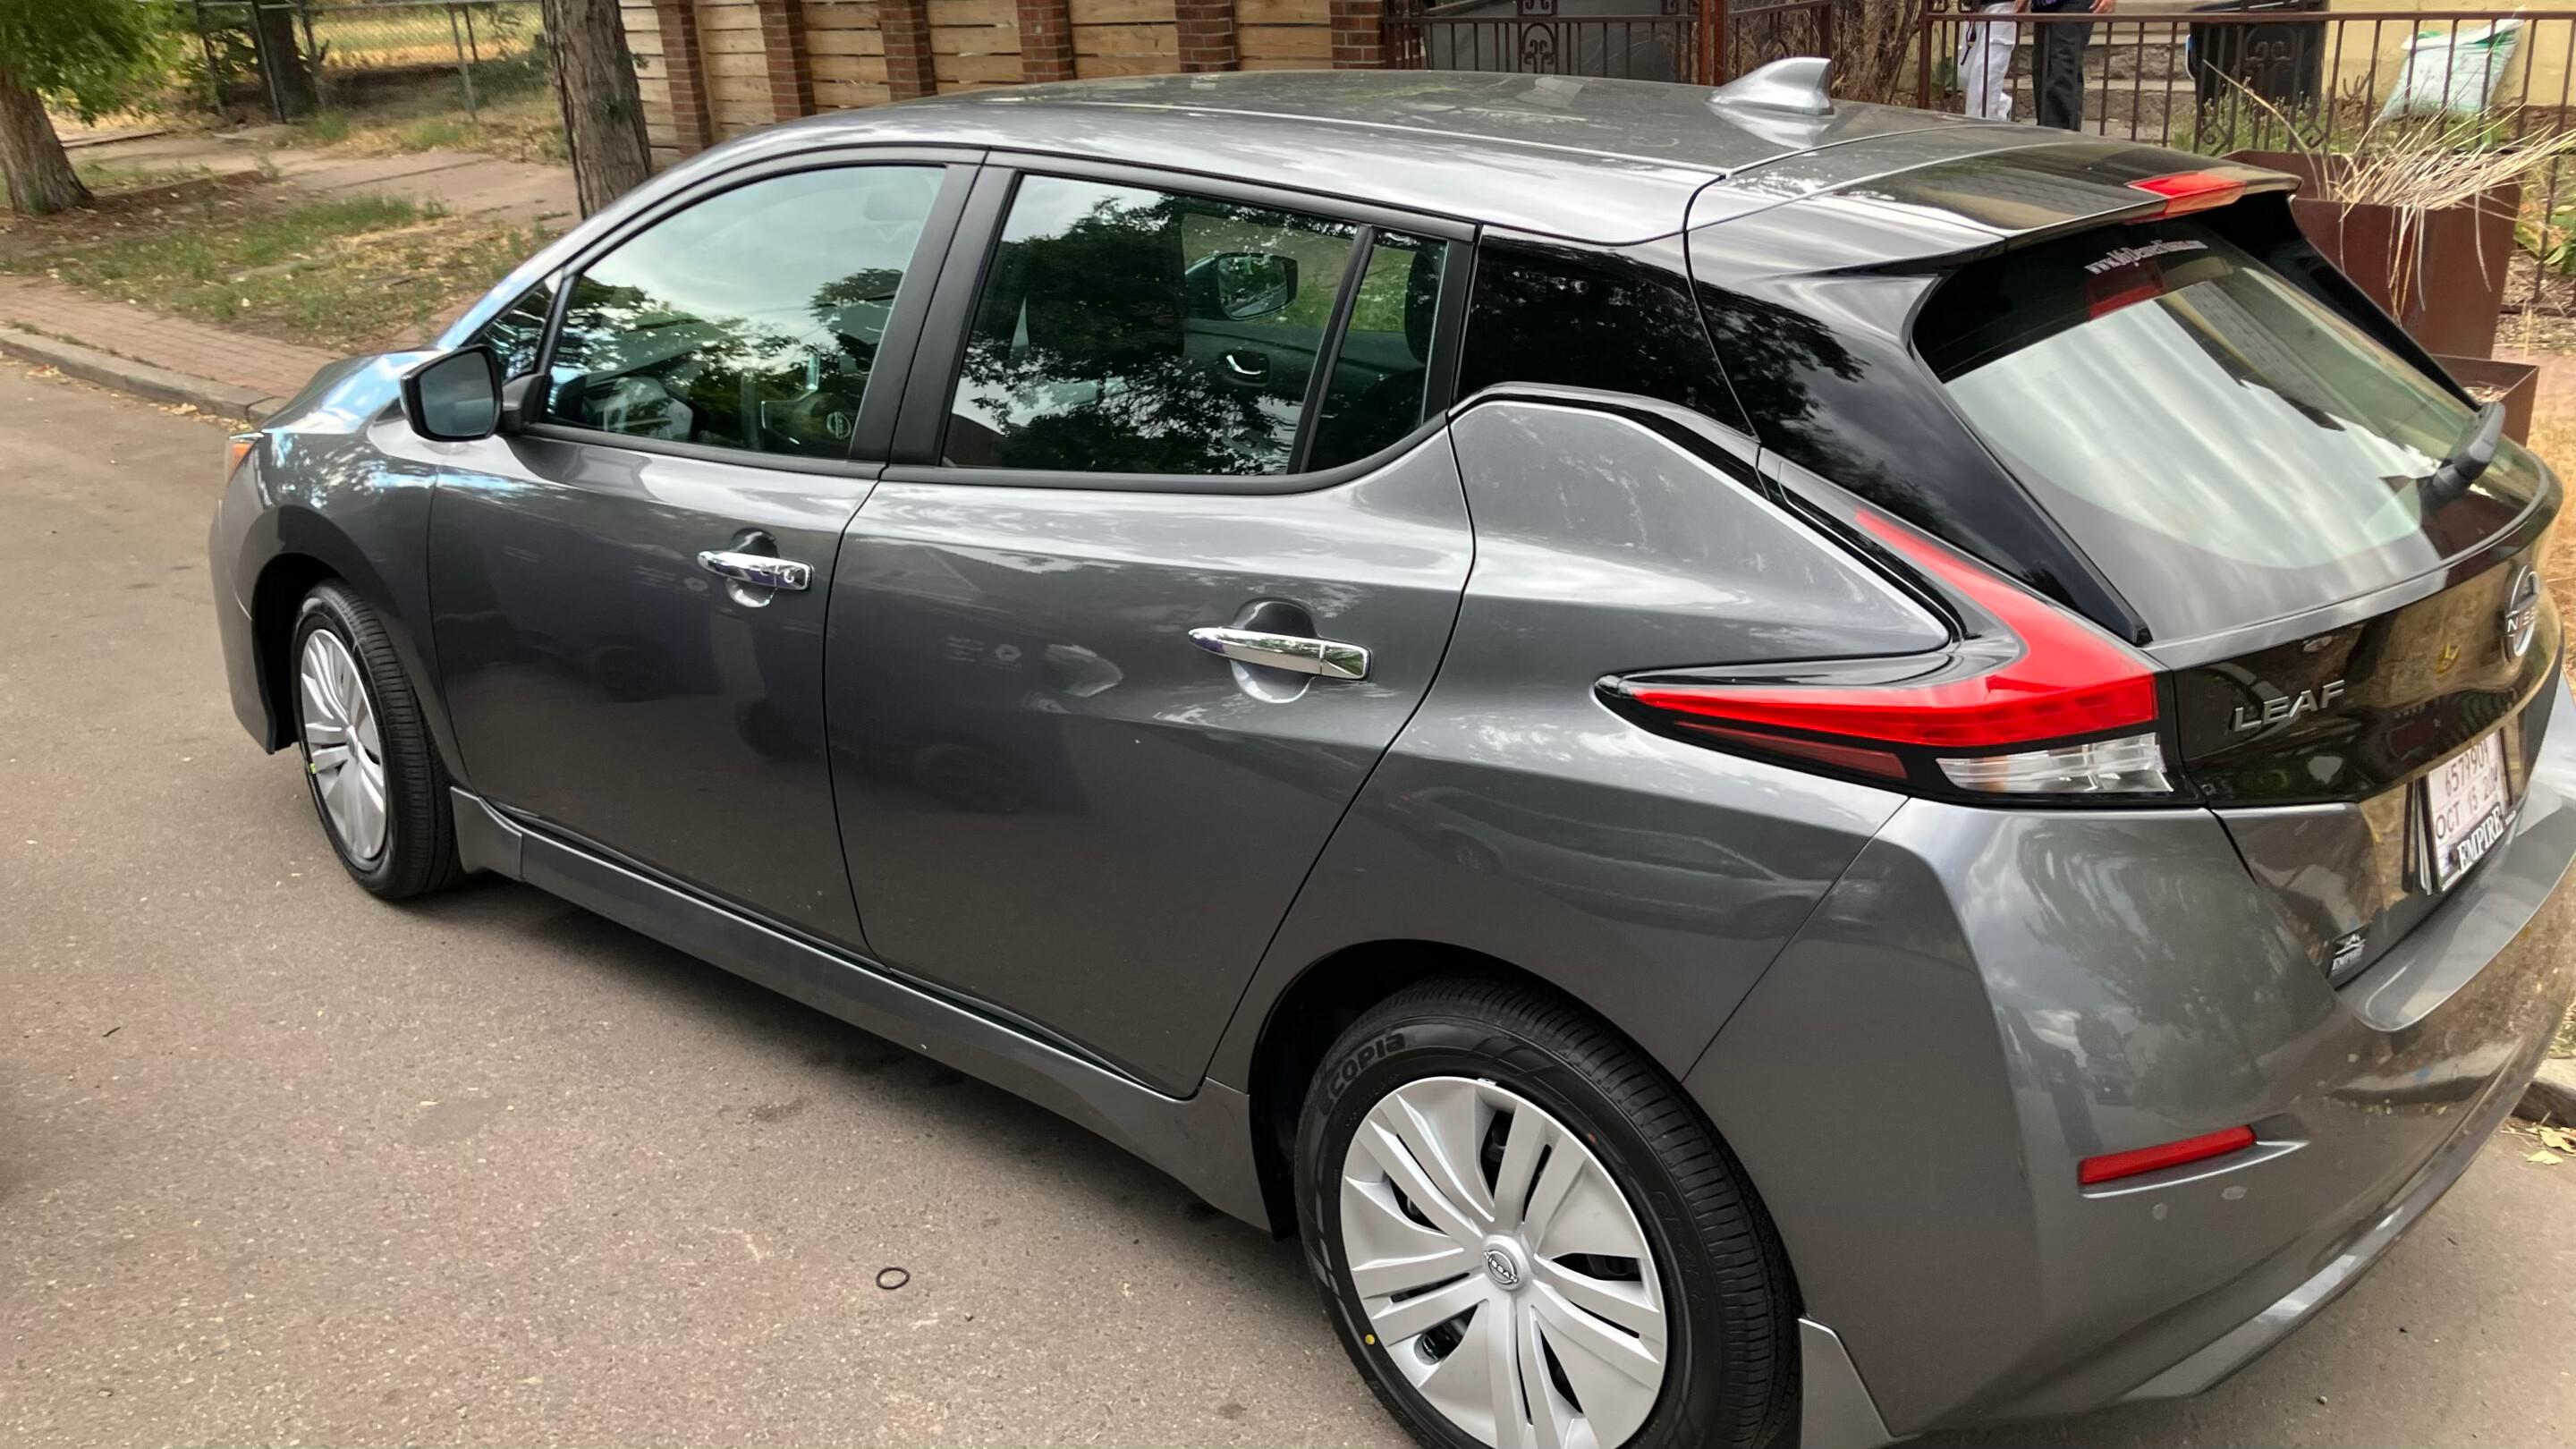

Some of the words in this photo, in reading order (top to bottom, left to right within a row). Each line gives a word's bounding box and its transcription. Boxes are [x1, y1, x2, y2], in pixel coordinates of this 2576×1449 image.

[2507, 607, 2537, 633] NISS
[2233, 679, 2345, 732] LEAF
[2435, 801, 2461, 840] OCT
[2456, 805, 2505, 876] EMPIRE
